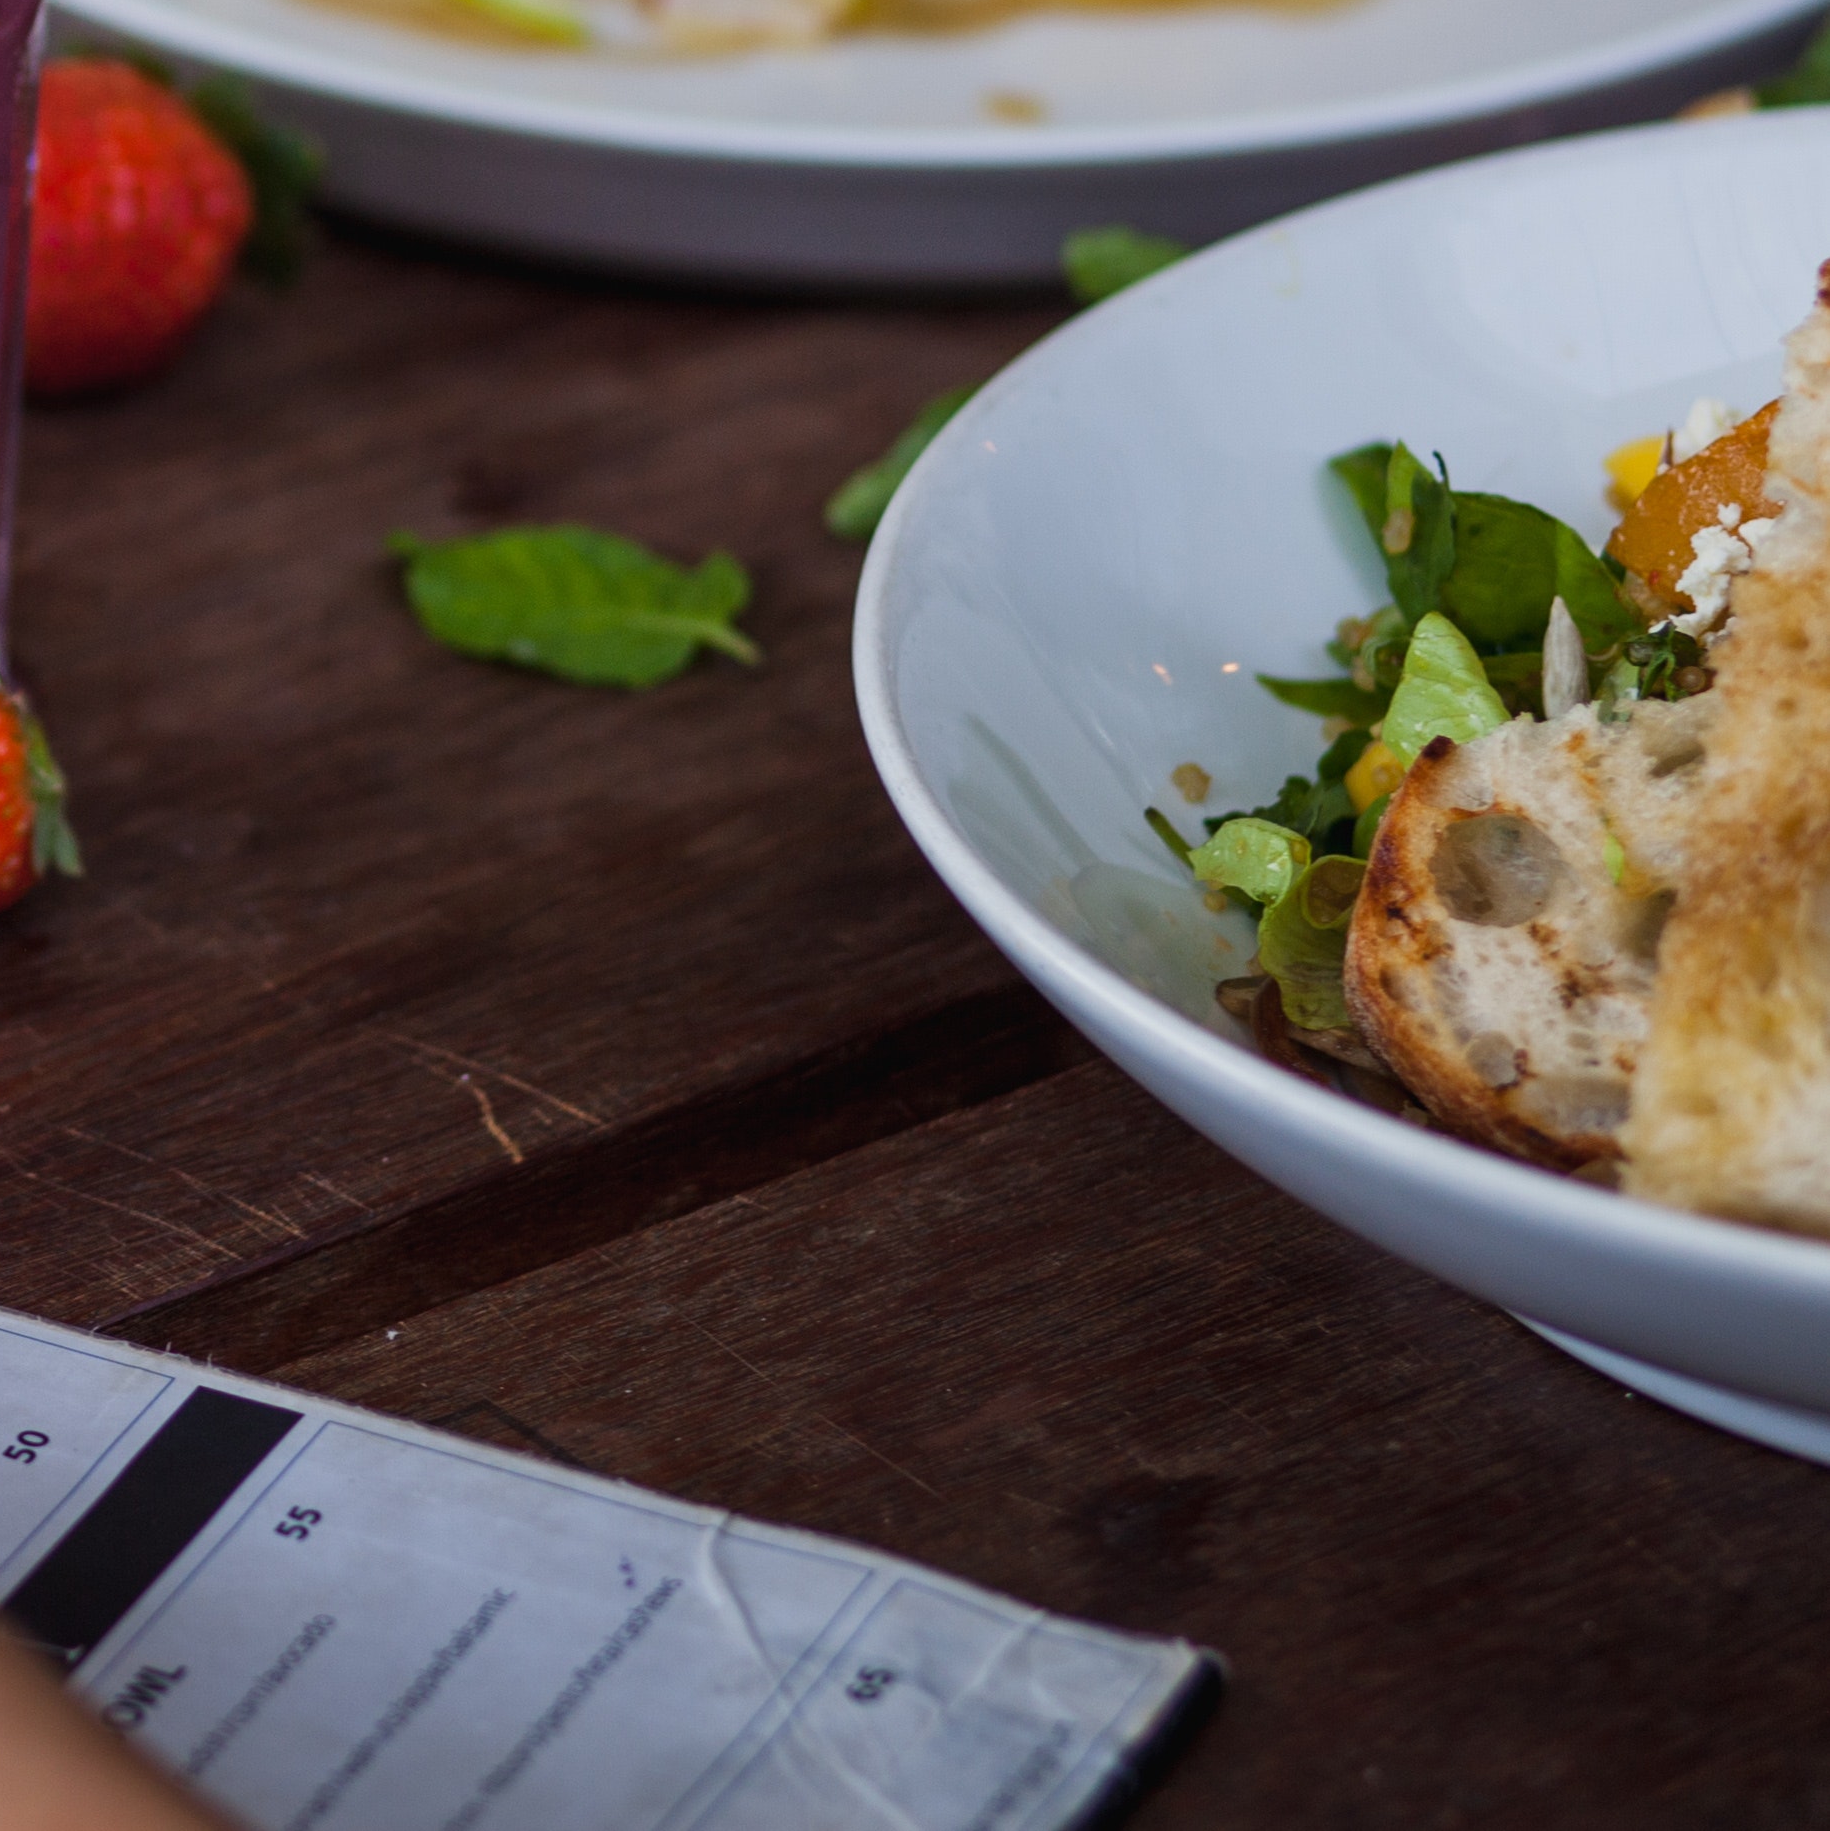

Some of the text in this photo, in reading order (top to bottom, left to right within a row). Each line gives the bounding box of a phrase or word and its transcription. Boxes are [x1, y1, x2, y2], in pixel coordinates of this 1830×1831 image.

[2, 1429, 50, 1465] 50
[272, 1505, 322, 1541] 55
[102, 1664, 189, 1731] OWL
[845, 1665, 896, 1706] 65
